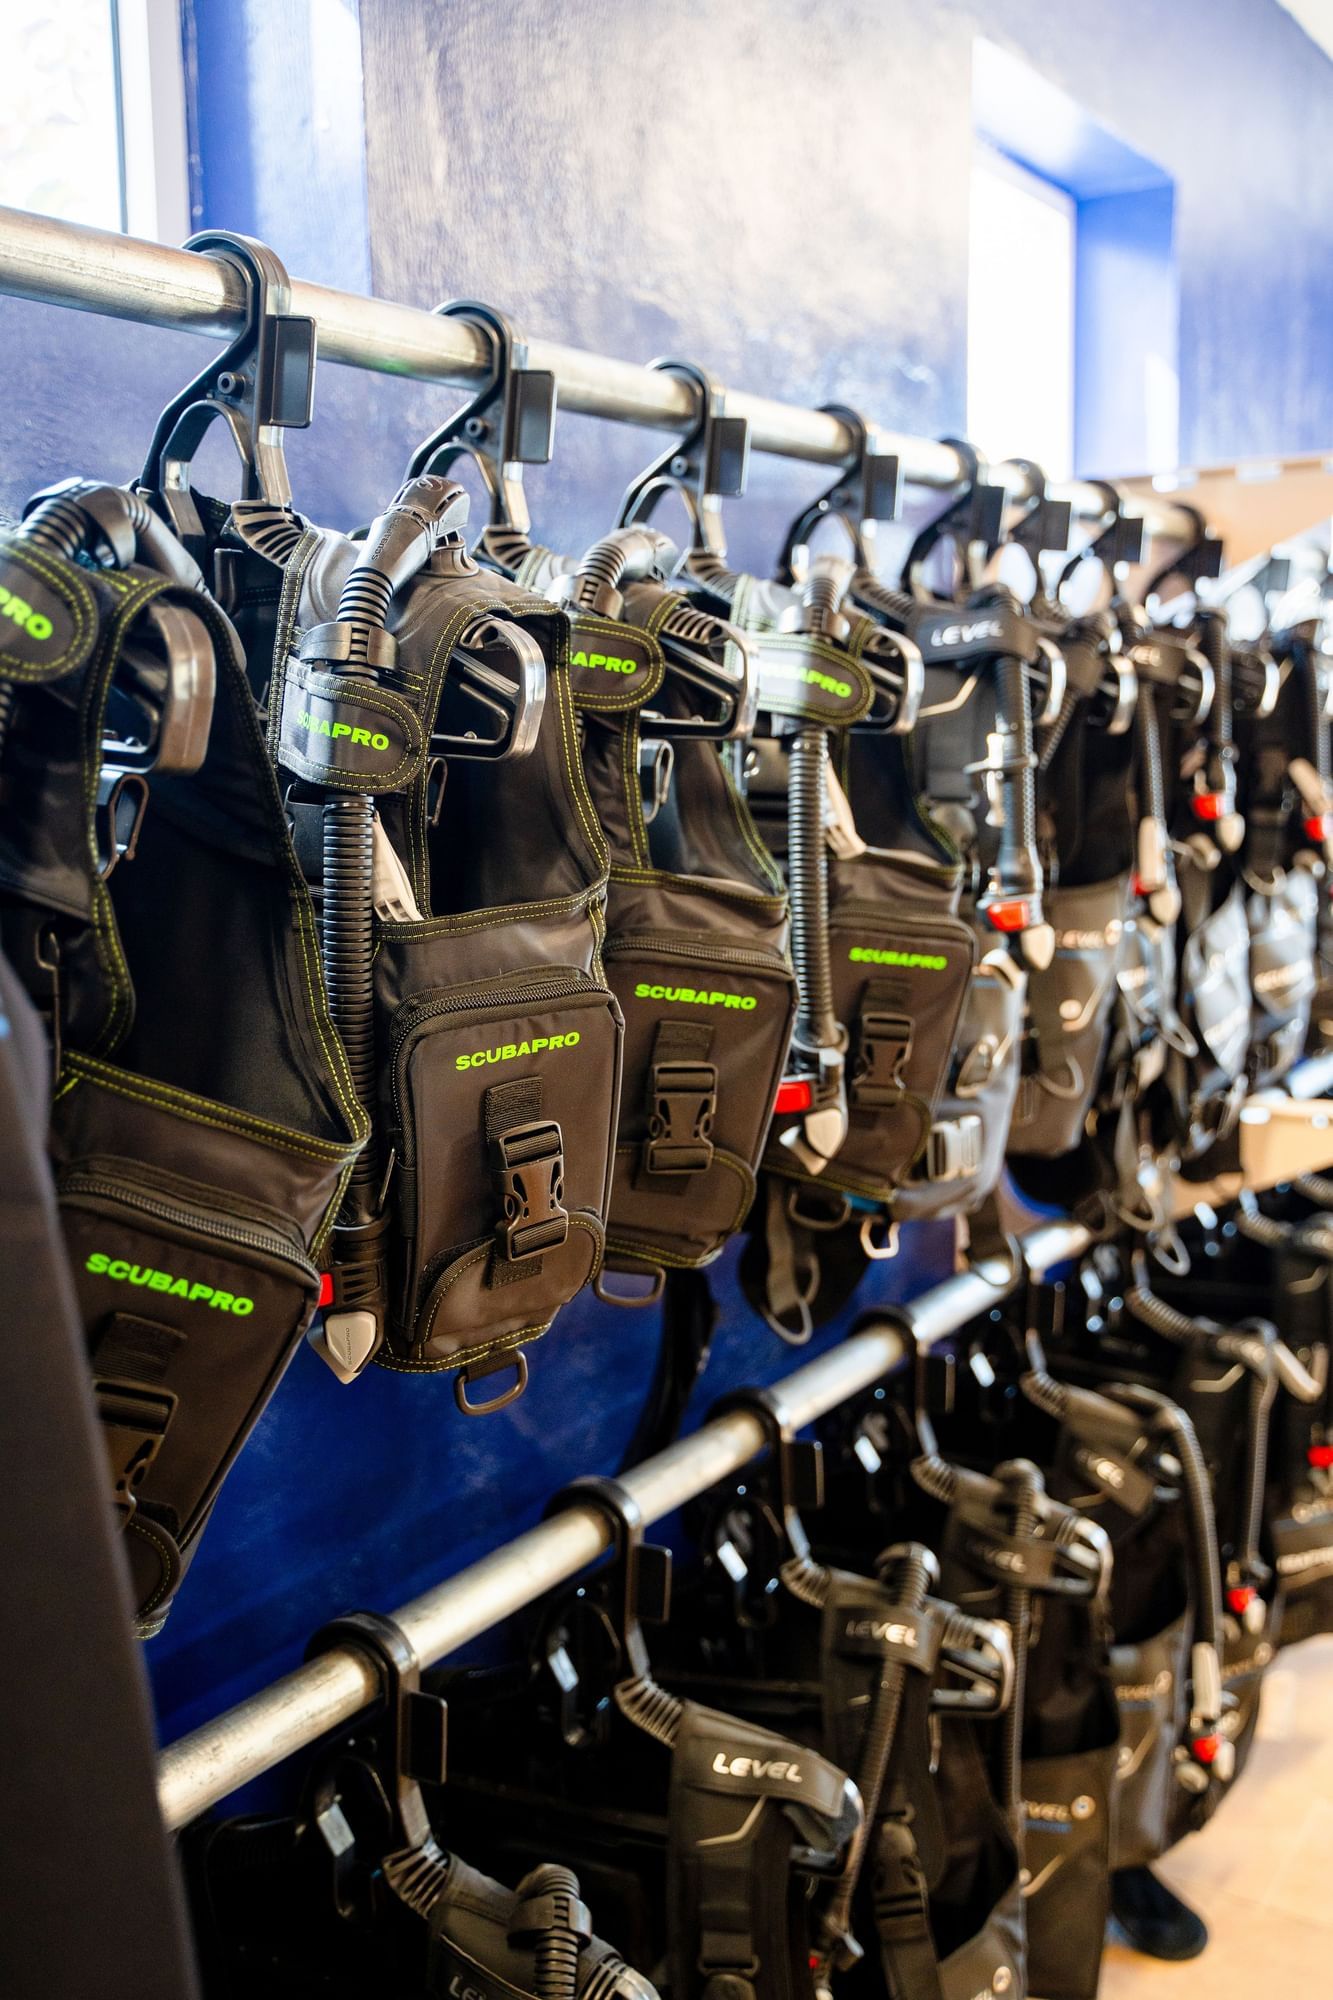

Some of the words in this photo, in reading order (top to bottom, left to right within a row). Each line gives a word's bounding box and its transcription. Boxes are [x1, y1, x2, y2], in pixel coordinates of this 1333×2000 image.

[931, 620, 1004, 647] LEVEL
[849, 947, 947, 970] SCUBAPRO
[635, 983, 757, 1010] SCUBAPRO
[455, 1031, 580, 1071] SCUBAPRO
[86, 1253, 254, 1316] SCUBAPRO
[846, 1620, 919, 1648] LEVEL
[712, 1752, 803, 1783] LEVEL
